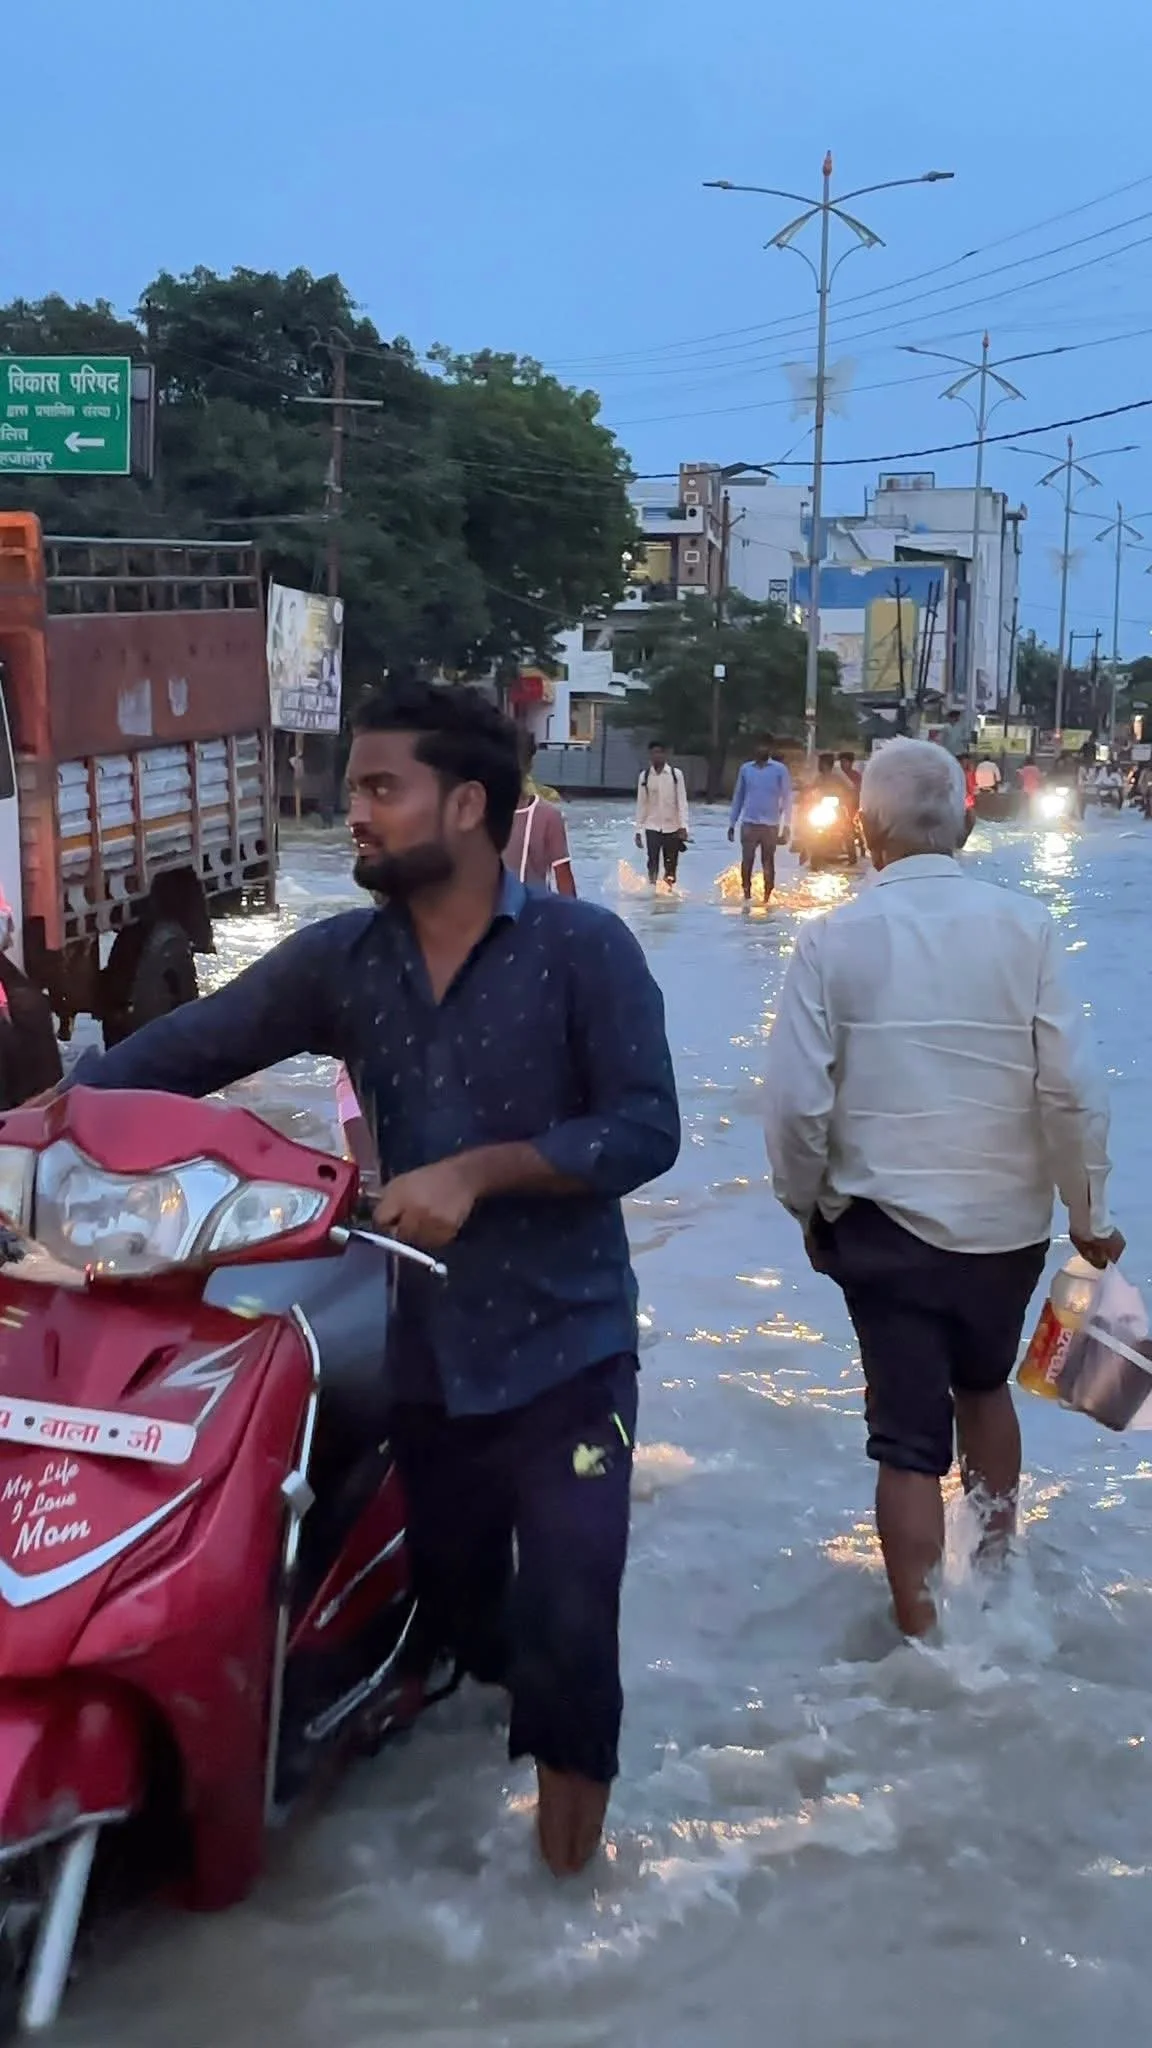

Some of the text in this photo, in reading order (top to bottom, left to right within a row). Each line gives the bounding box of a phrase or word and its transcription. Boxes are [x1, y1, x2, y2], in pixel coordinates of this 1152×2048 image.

[8, 364, 120, 394] विकास परिषद
[2, 1457, 80, 1499] My Life
[28, 1491, 77, 1517] Love
[12, 1516, 91, 1559] Mom
